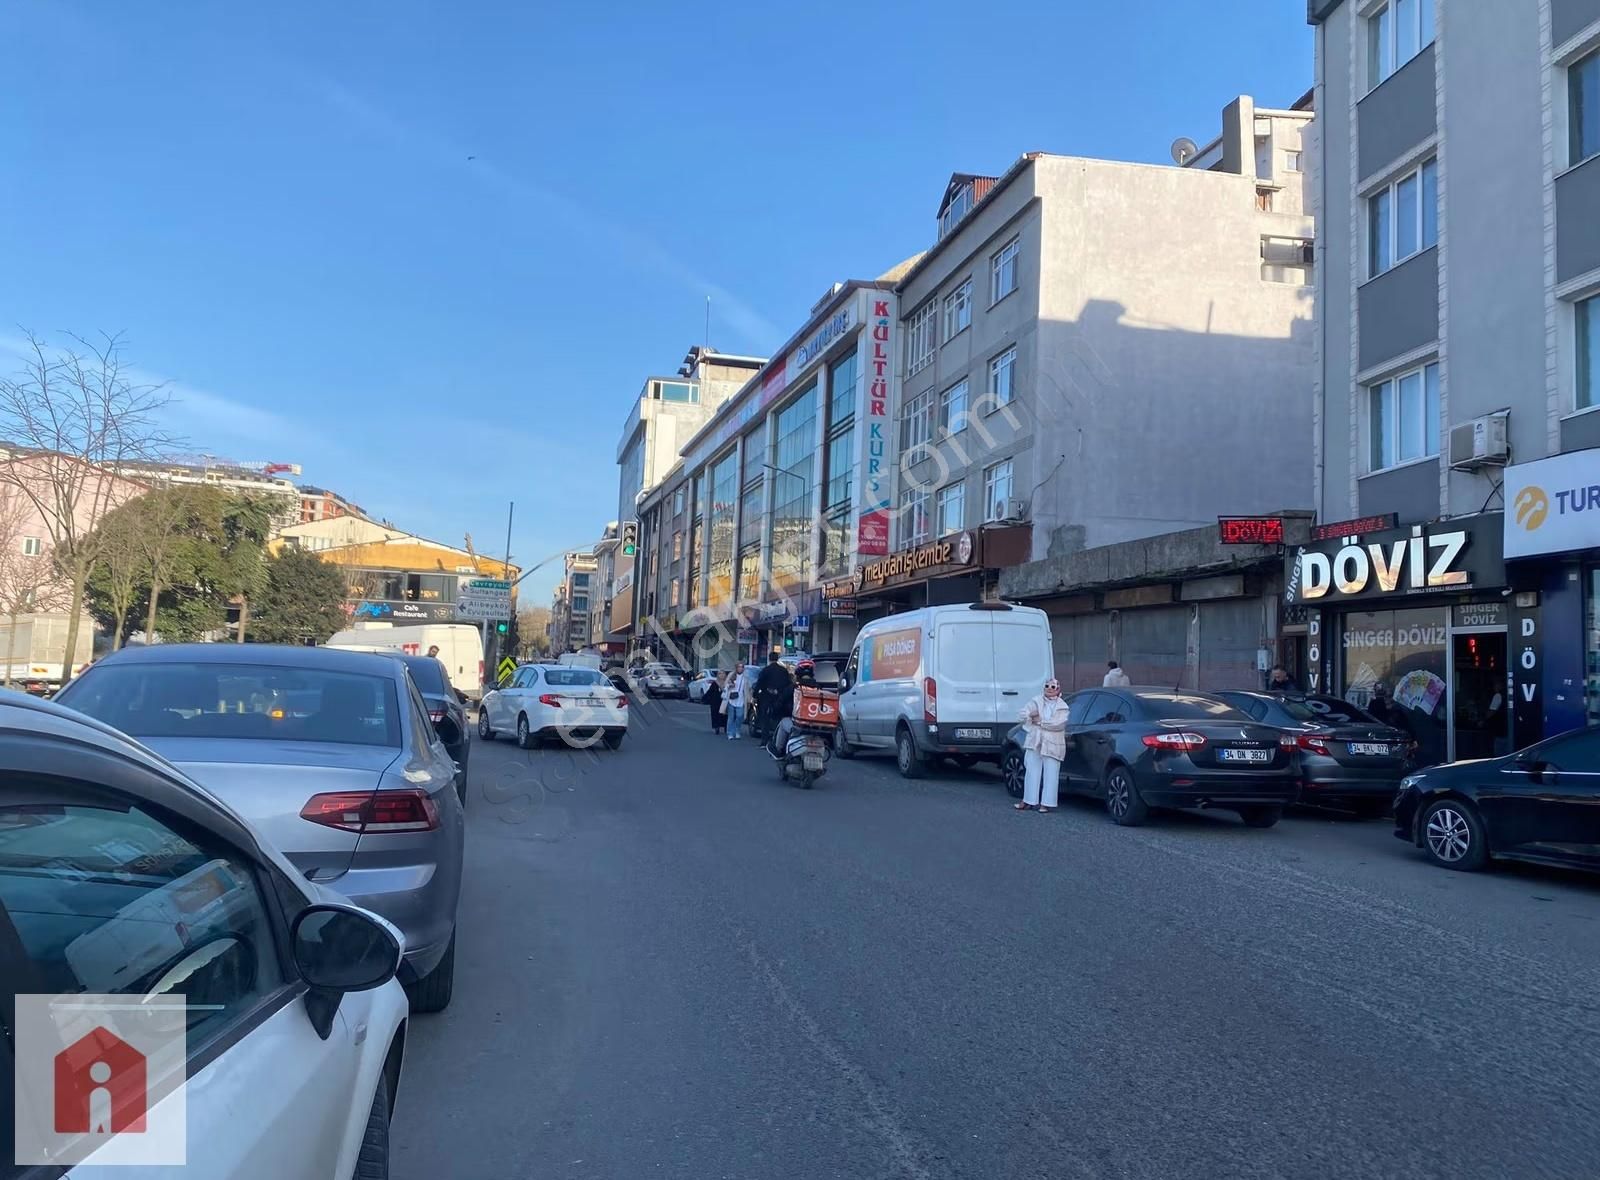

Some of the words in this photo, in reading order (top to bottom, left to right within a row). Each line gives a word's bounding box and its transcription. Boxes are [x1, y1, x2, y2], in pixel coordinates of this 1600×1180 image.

[871, 301, 889, 416] KÜLTÜR
[868, 423, 885, 491] KURS
[1302, 525, 1467, 599] DÖVİZ
[1343, 627, 1394, 648] SİNGER
[1398, 623, 1446, 646] DÖVİZ
[808, 703, 835, 718] go
[1224, 750, 1233, 759] 34
